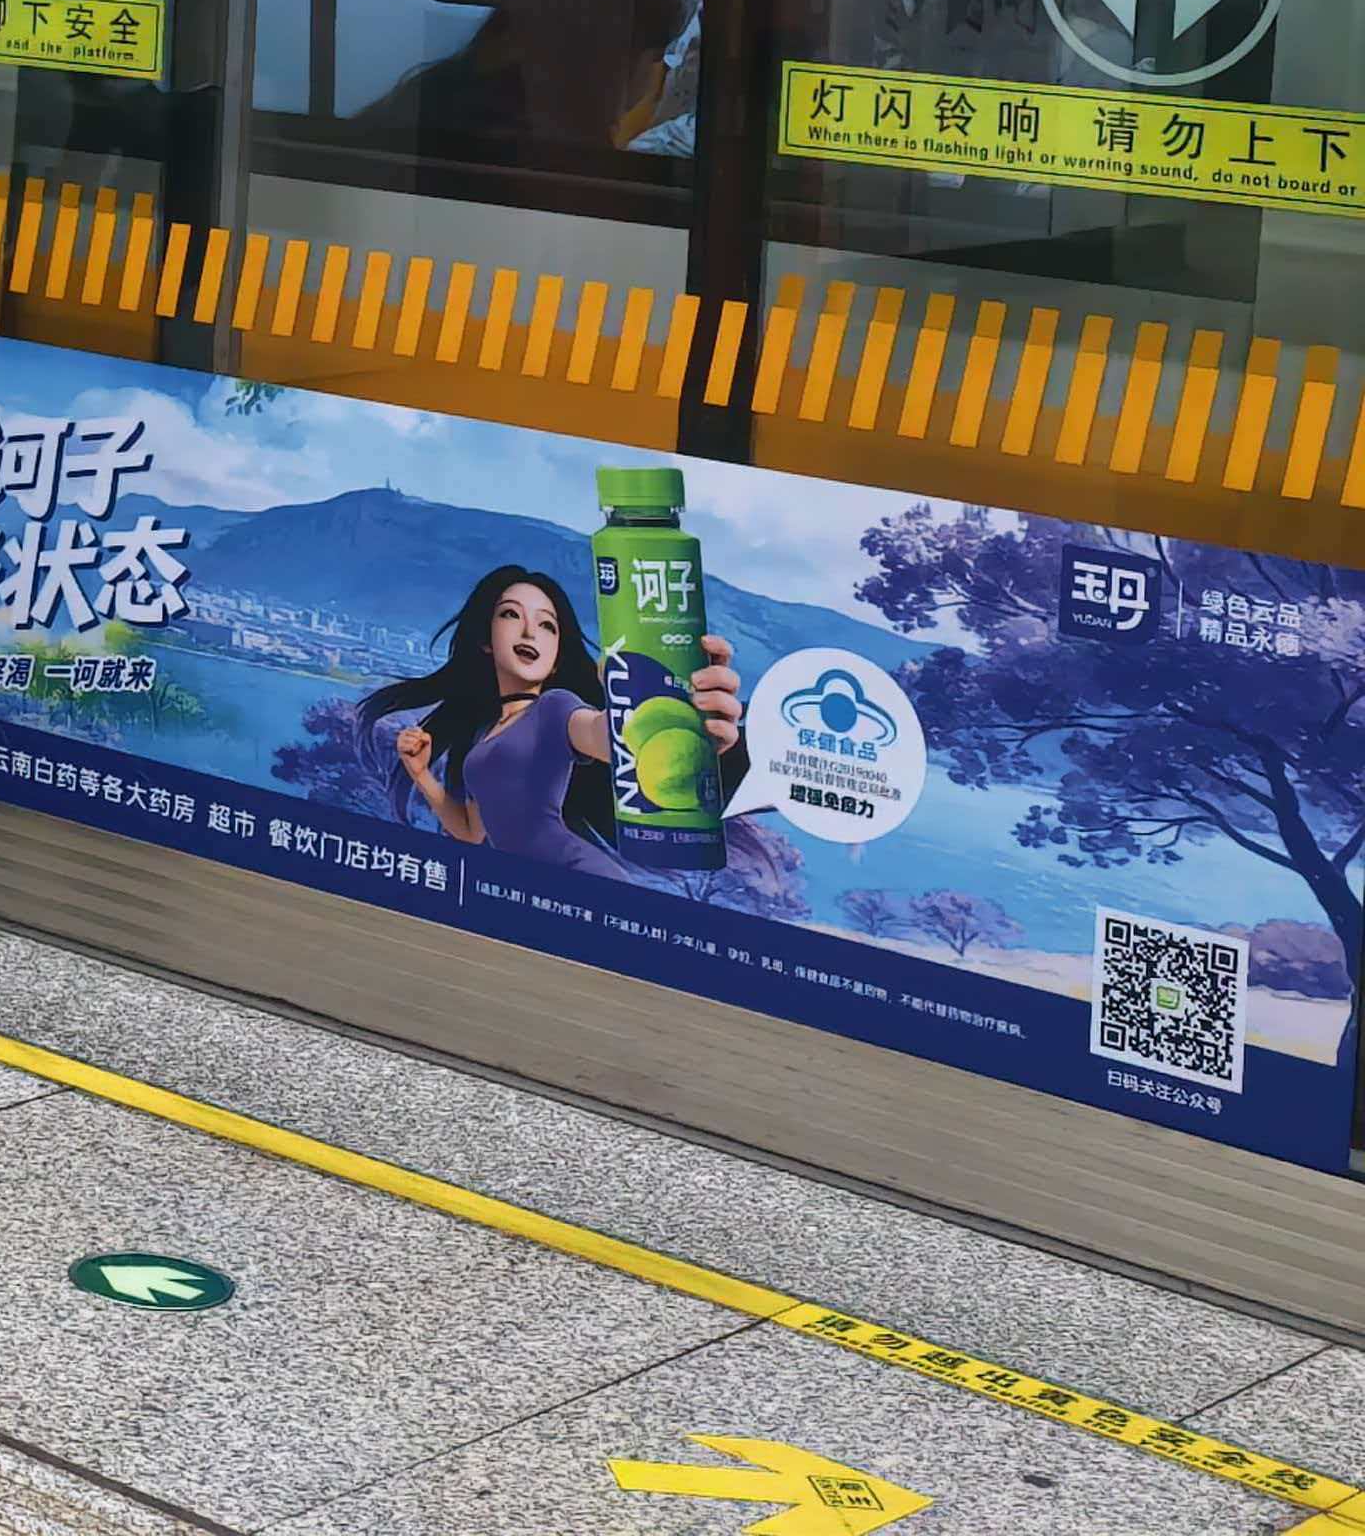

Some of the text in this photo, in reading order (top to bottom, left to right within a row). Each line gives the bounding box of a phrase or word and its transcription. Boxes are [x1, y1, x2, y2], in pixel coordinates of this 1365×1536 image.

[6, 38, 30, 52] and
[40, 40, 63, 55] the
[810, 78, 1351, 174] 灯闪铃响 请勿上下
[807, 124, 1357, 196] When there is flashing light or warning sound, do not board or
[630, 558, 697, 613] 诃子
[1199, 589, 1302, 629] 绿色云品
[1199, 616, 1302, 658] 精品永德
[42, 656, 157, 692] 一诃就来
[604, 634, 643, 816] YUDAN
[797, 727, 878, 763] 保健食品
[789, 783, 875, 819] 增强免疫力
[207, 802, 256, 839] 超市
[268, 818, 449, 893] 餐饮门店均有售
[1107, 1068, 1223, 1115] 扫码关注公众号
[815, 1314, 1318, 1490] 请勿越出黄色安全线
